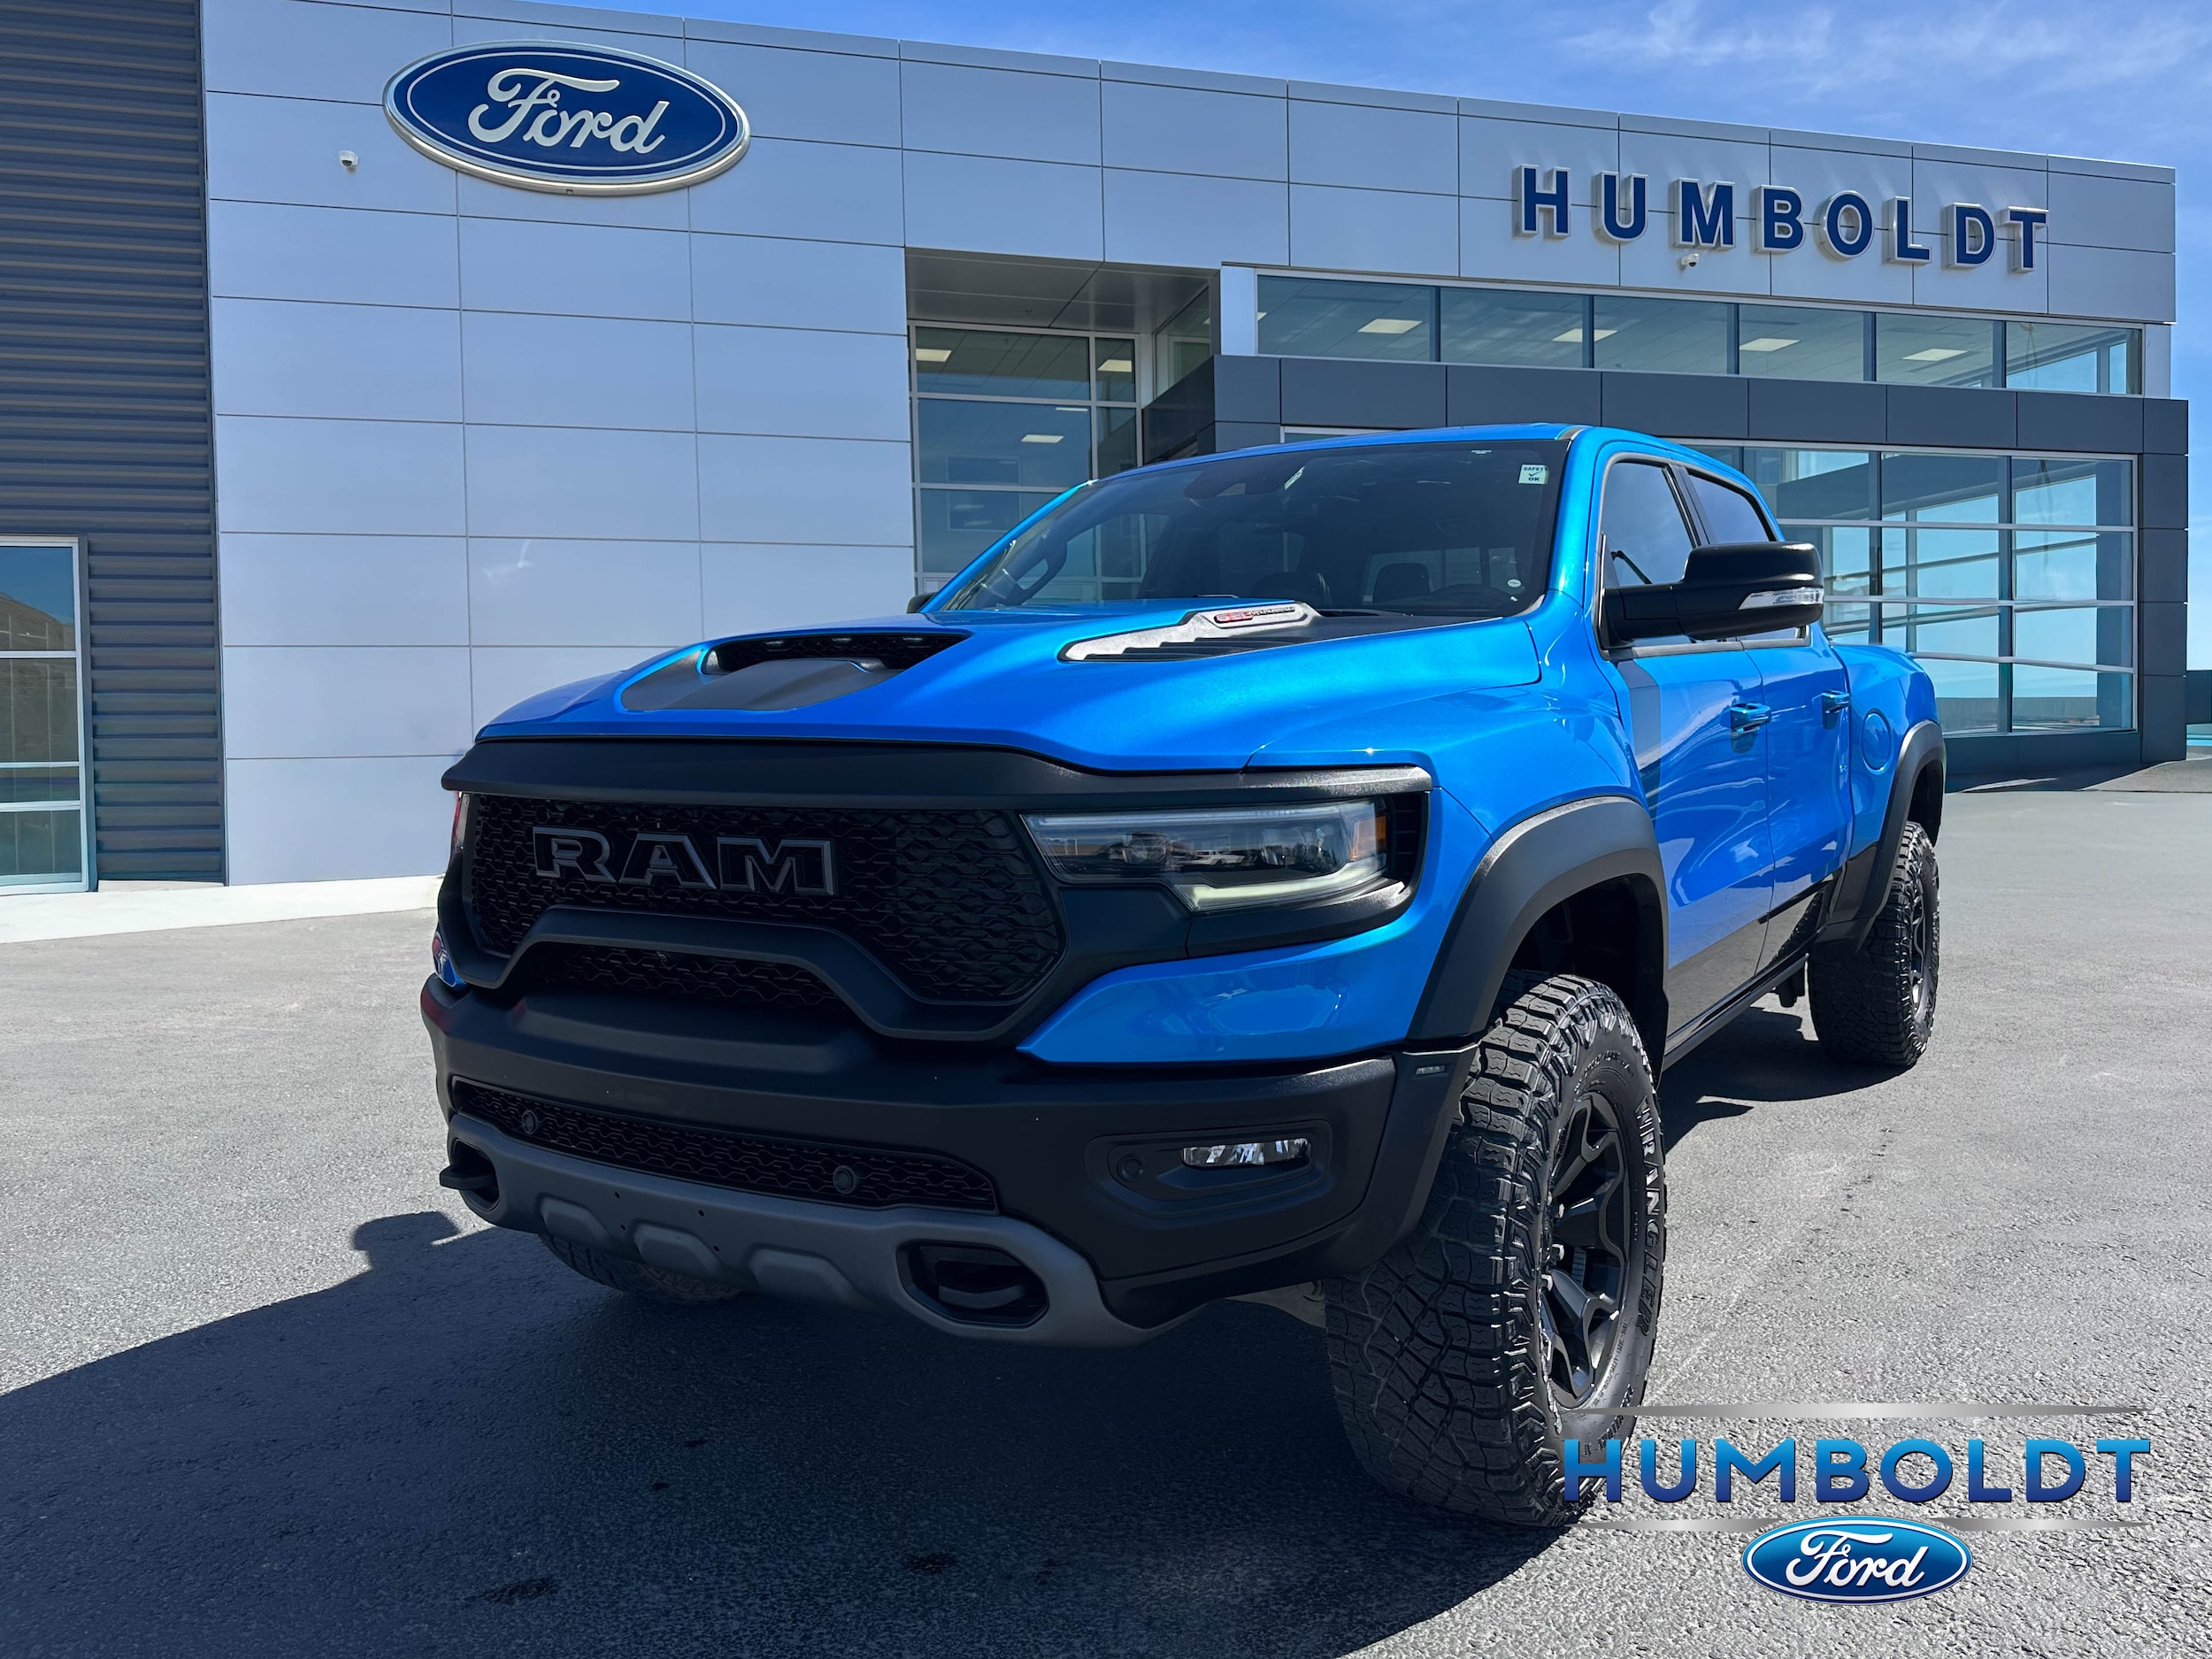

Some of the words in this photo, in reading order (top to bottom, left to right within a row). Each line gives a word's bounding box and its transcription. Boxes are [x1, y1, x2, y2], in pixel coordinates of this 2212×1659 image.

[468, 68, 670, 154] Ford
[1515, 164, 2048, 273] HUMBOLDT
[532, 826, 835, 896] RAM
[1634, 1094, 1661, 1337] WRANGLER
